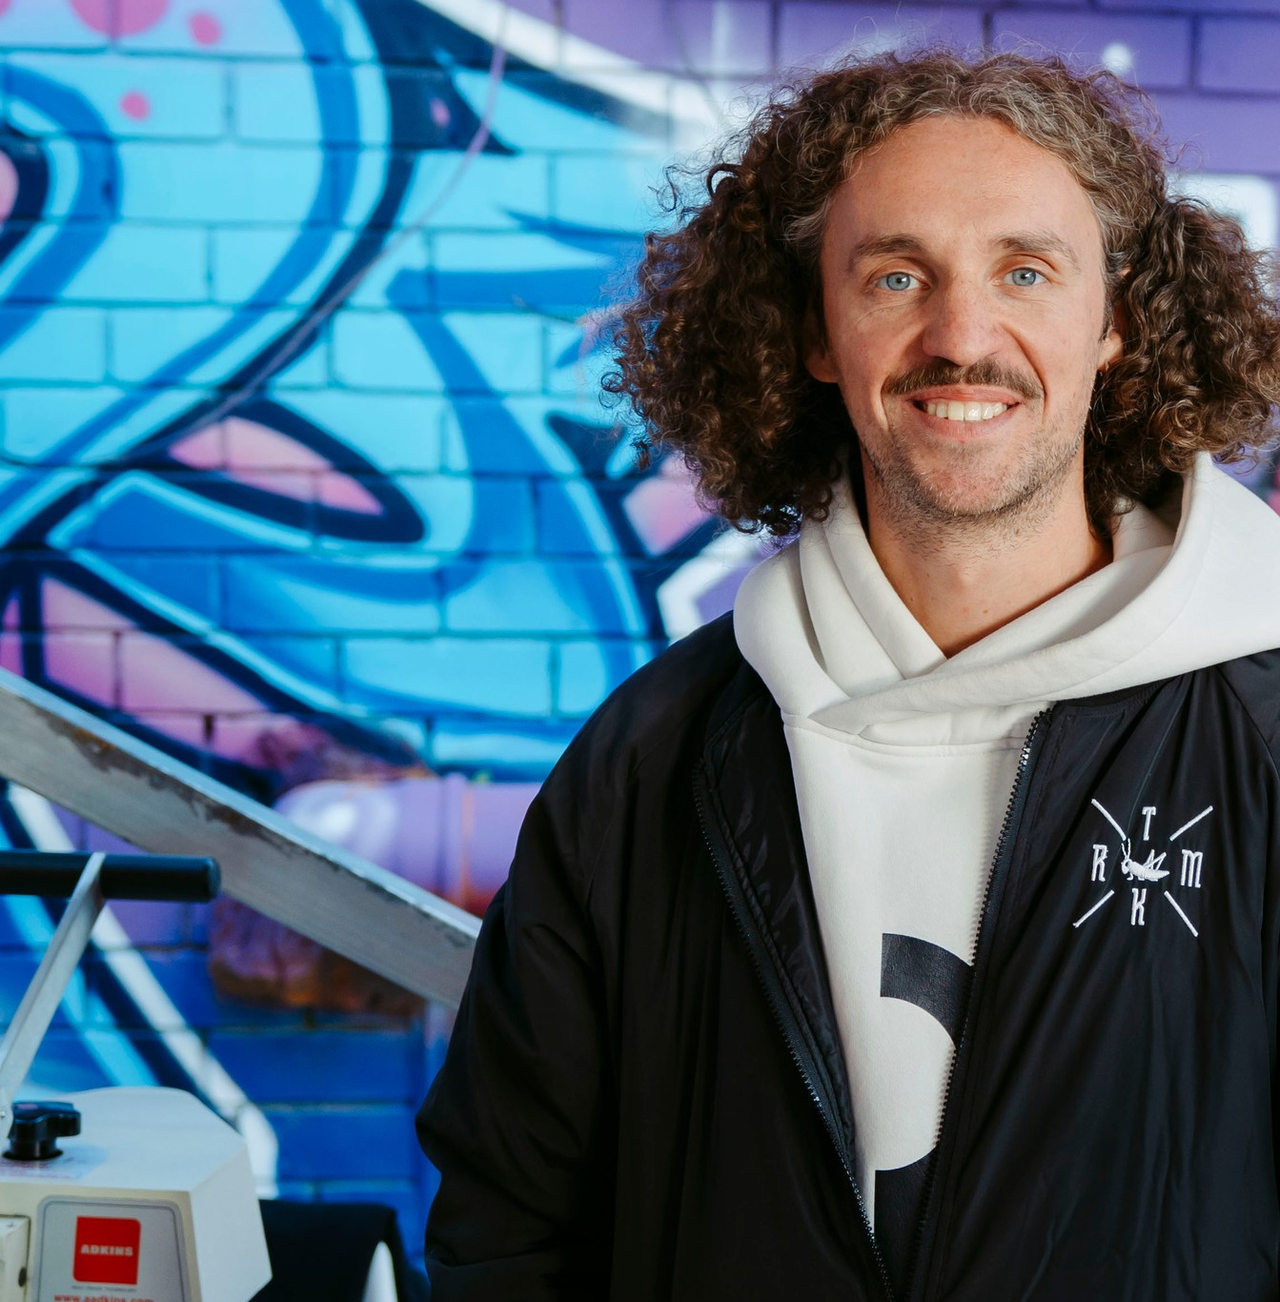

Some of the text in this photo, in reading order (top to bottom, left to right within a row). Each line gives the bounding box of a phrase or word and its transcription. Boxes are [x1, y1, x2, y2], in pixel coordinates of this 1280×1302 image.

[1142, 806, 1156, 841] T
[1091, 844, 1203, 888] R M
[1130, 888, 1147, 926] K
[81, 1244, 134, 1256] ADKINS
